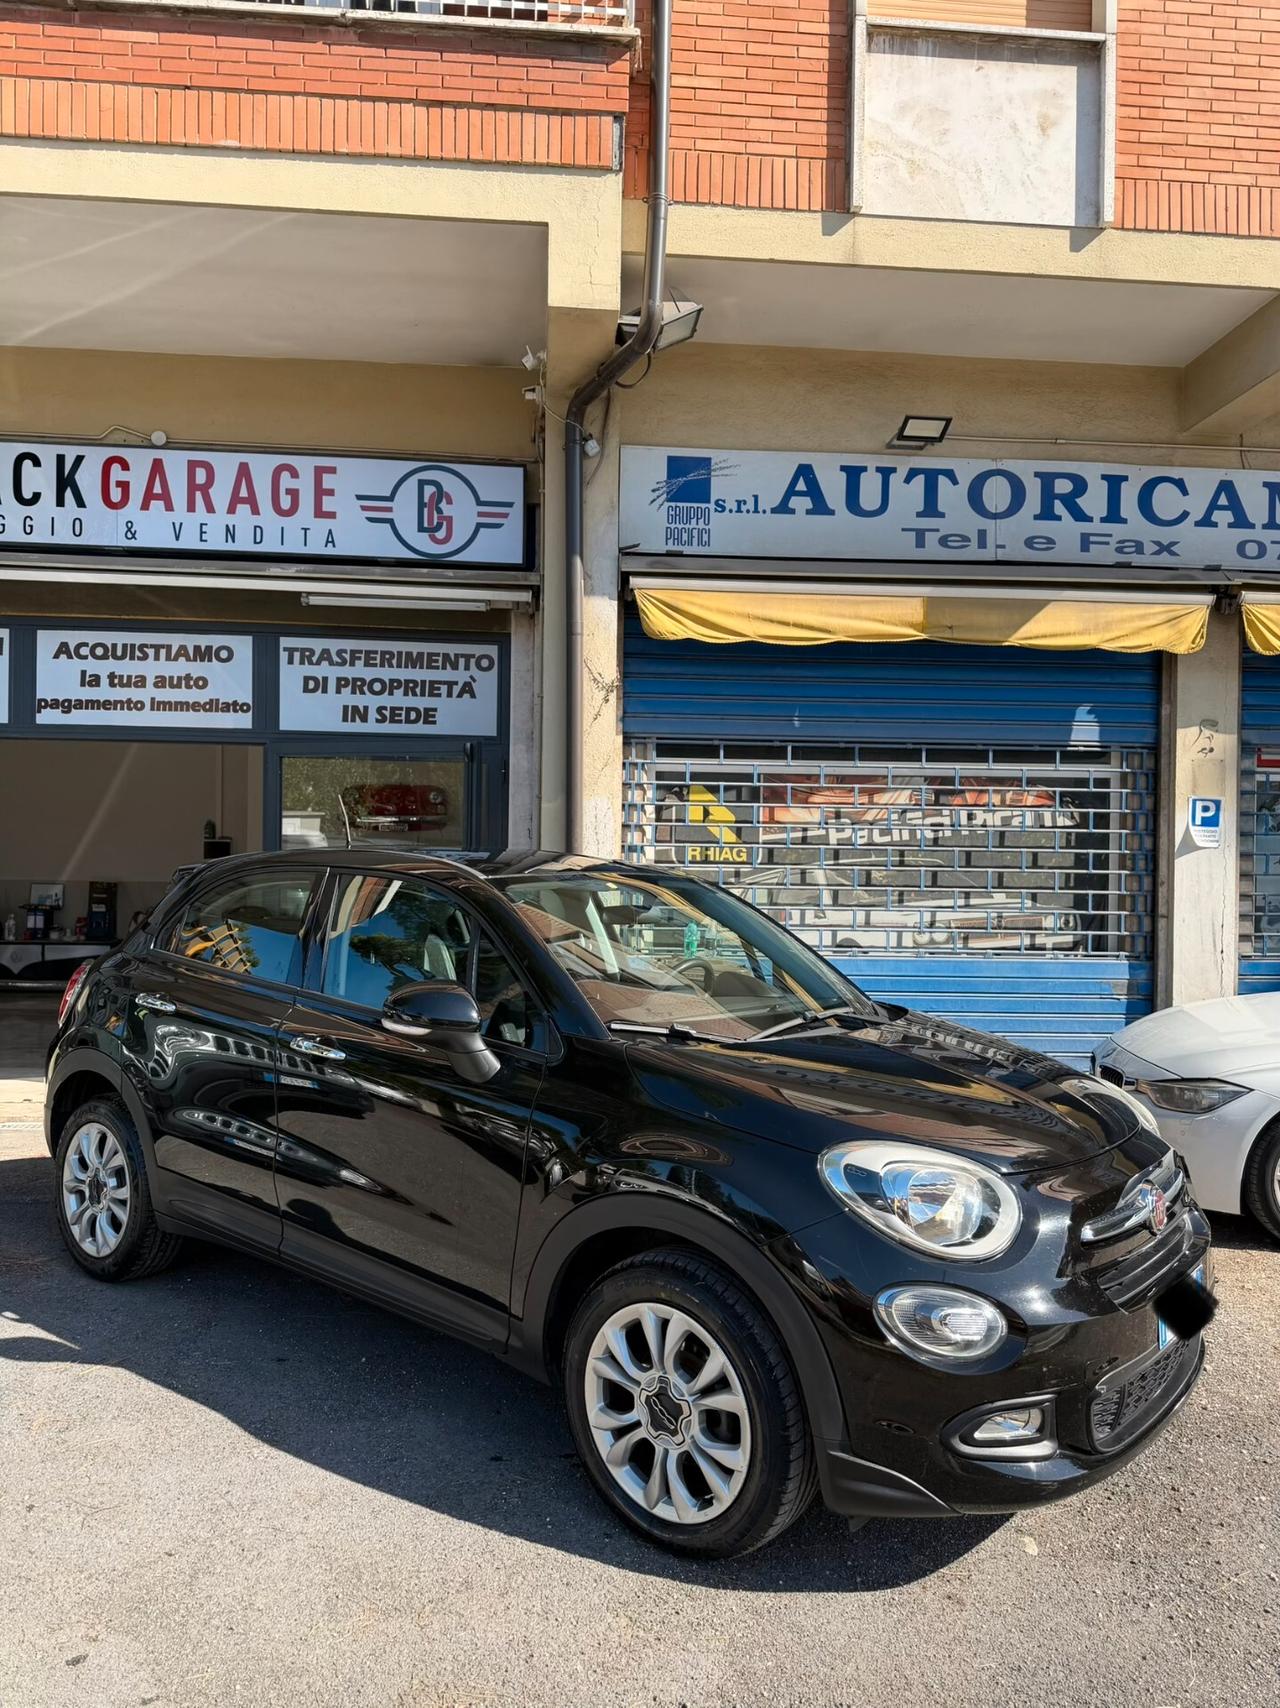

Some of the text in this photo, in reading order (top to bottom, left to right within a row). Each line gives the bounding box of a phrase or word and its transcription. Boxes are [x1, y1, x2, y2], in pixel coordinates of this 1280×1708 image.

[713, 463, 1280, 531] s.r.l. AUTORICA
[666, 504, 711, 526] GRUPPO
[124, 519, 138, 541] &
[172, 521, 337, 549] VENDITA
[665, 526, 711, 548] PACIFICI
[901, 527, 1007, 550] Tel.
[1023, 534, 1057, 552] e
[1081, 532, 1181, 557] Fax
[52, 641, 235, 664] ACQUISTIAMO
[283, 646, 496, 673] TRASFERIMENTO
[80, 669, 209, 690] la tua auto
[302, 674, 478, 699] DI PROPRIETÀ
[36, 697, 252, 714] pagamento immediato
[341, 704, 438, 725] IN SEDE
[1195, 800, 1217, 825] P
[687, 846, 748, 862] RHIAG
